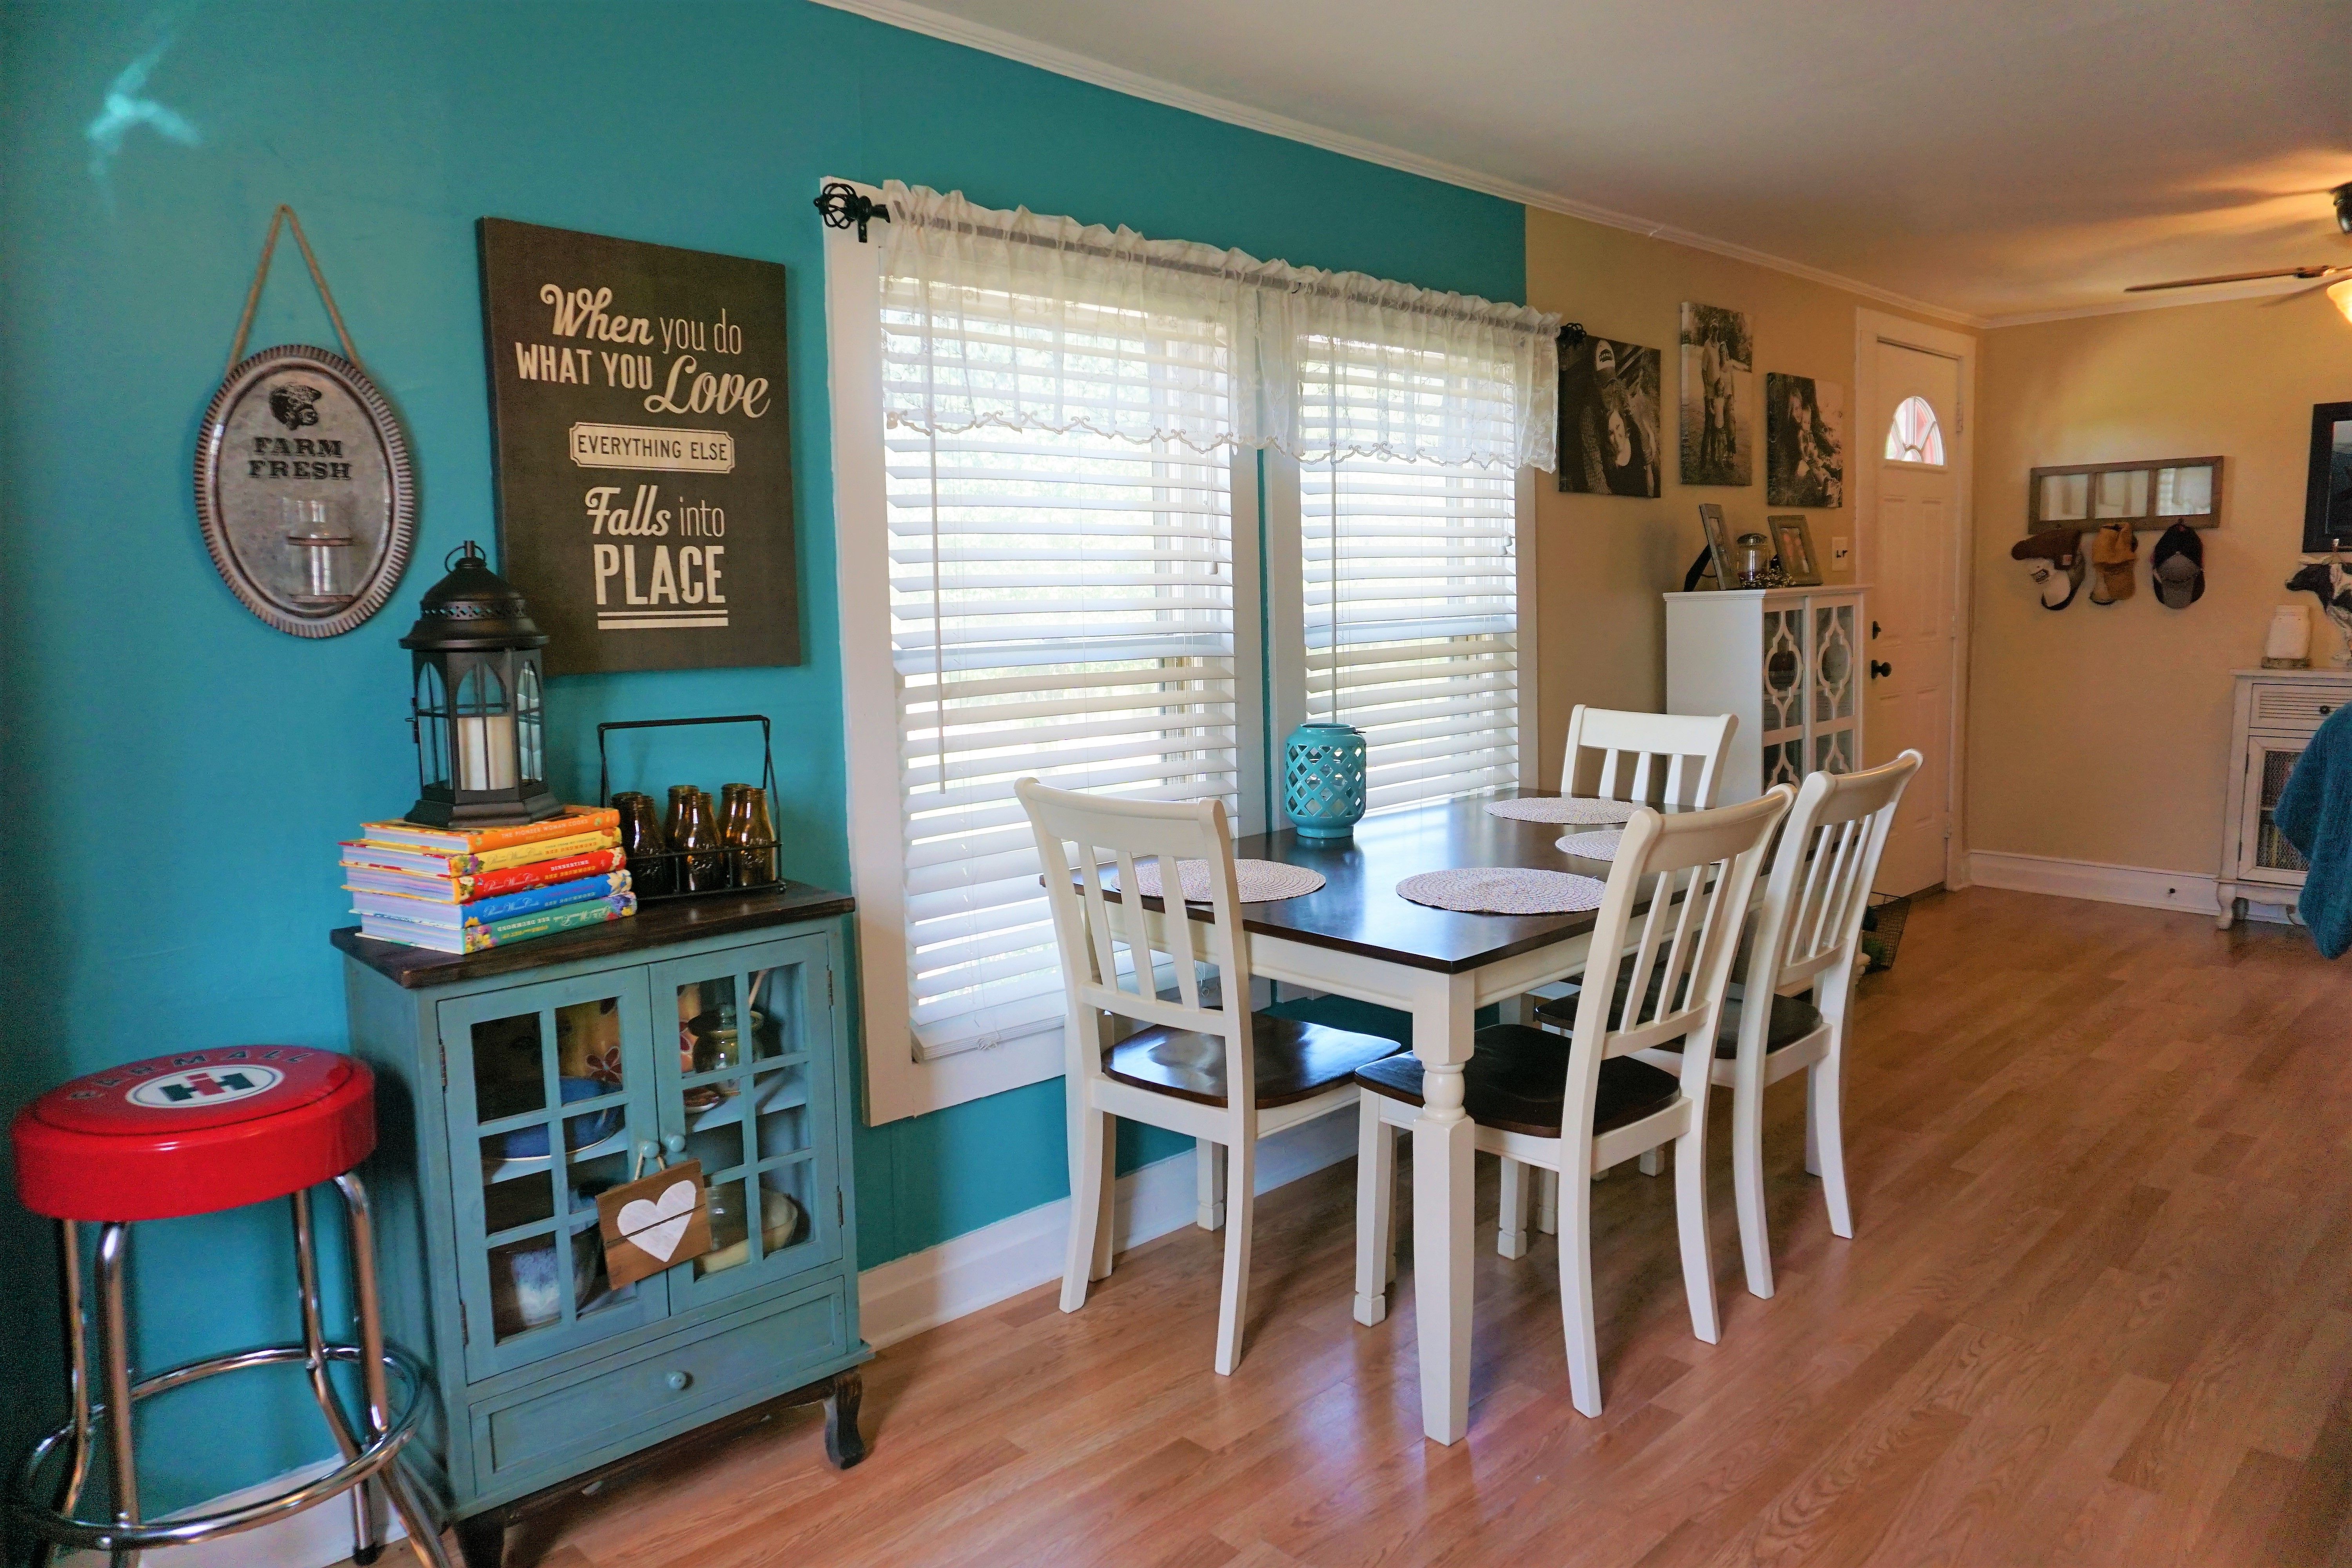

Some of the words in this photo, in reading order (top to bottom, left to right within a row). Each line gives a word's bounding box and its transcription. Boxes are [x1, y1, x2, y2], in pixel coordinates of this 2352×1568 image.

[540, 284, 653, 345] When
[660, 318, 706, 354] you
[714, 308, 742, 354] do
[515, 342, 592, 385] WHAT
[601, 352, 652, 390] YOU
[644, 355, 770, 418] Love
[249, 460, 352, 480] FRESH
[254, 437, 343, 458] FARM
[578, 435, 681, 459] EVERYTHING
[691, 442, 727, 461] ELSE
[585, 485, 671, 536] Falls
[680, 497, 724, 537] into
[593, 544, 726, 605] PLACE
